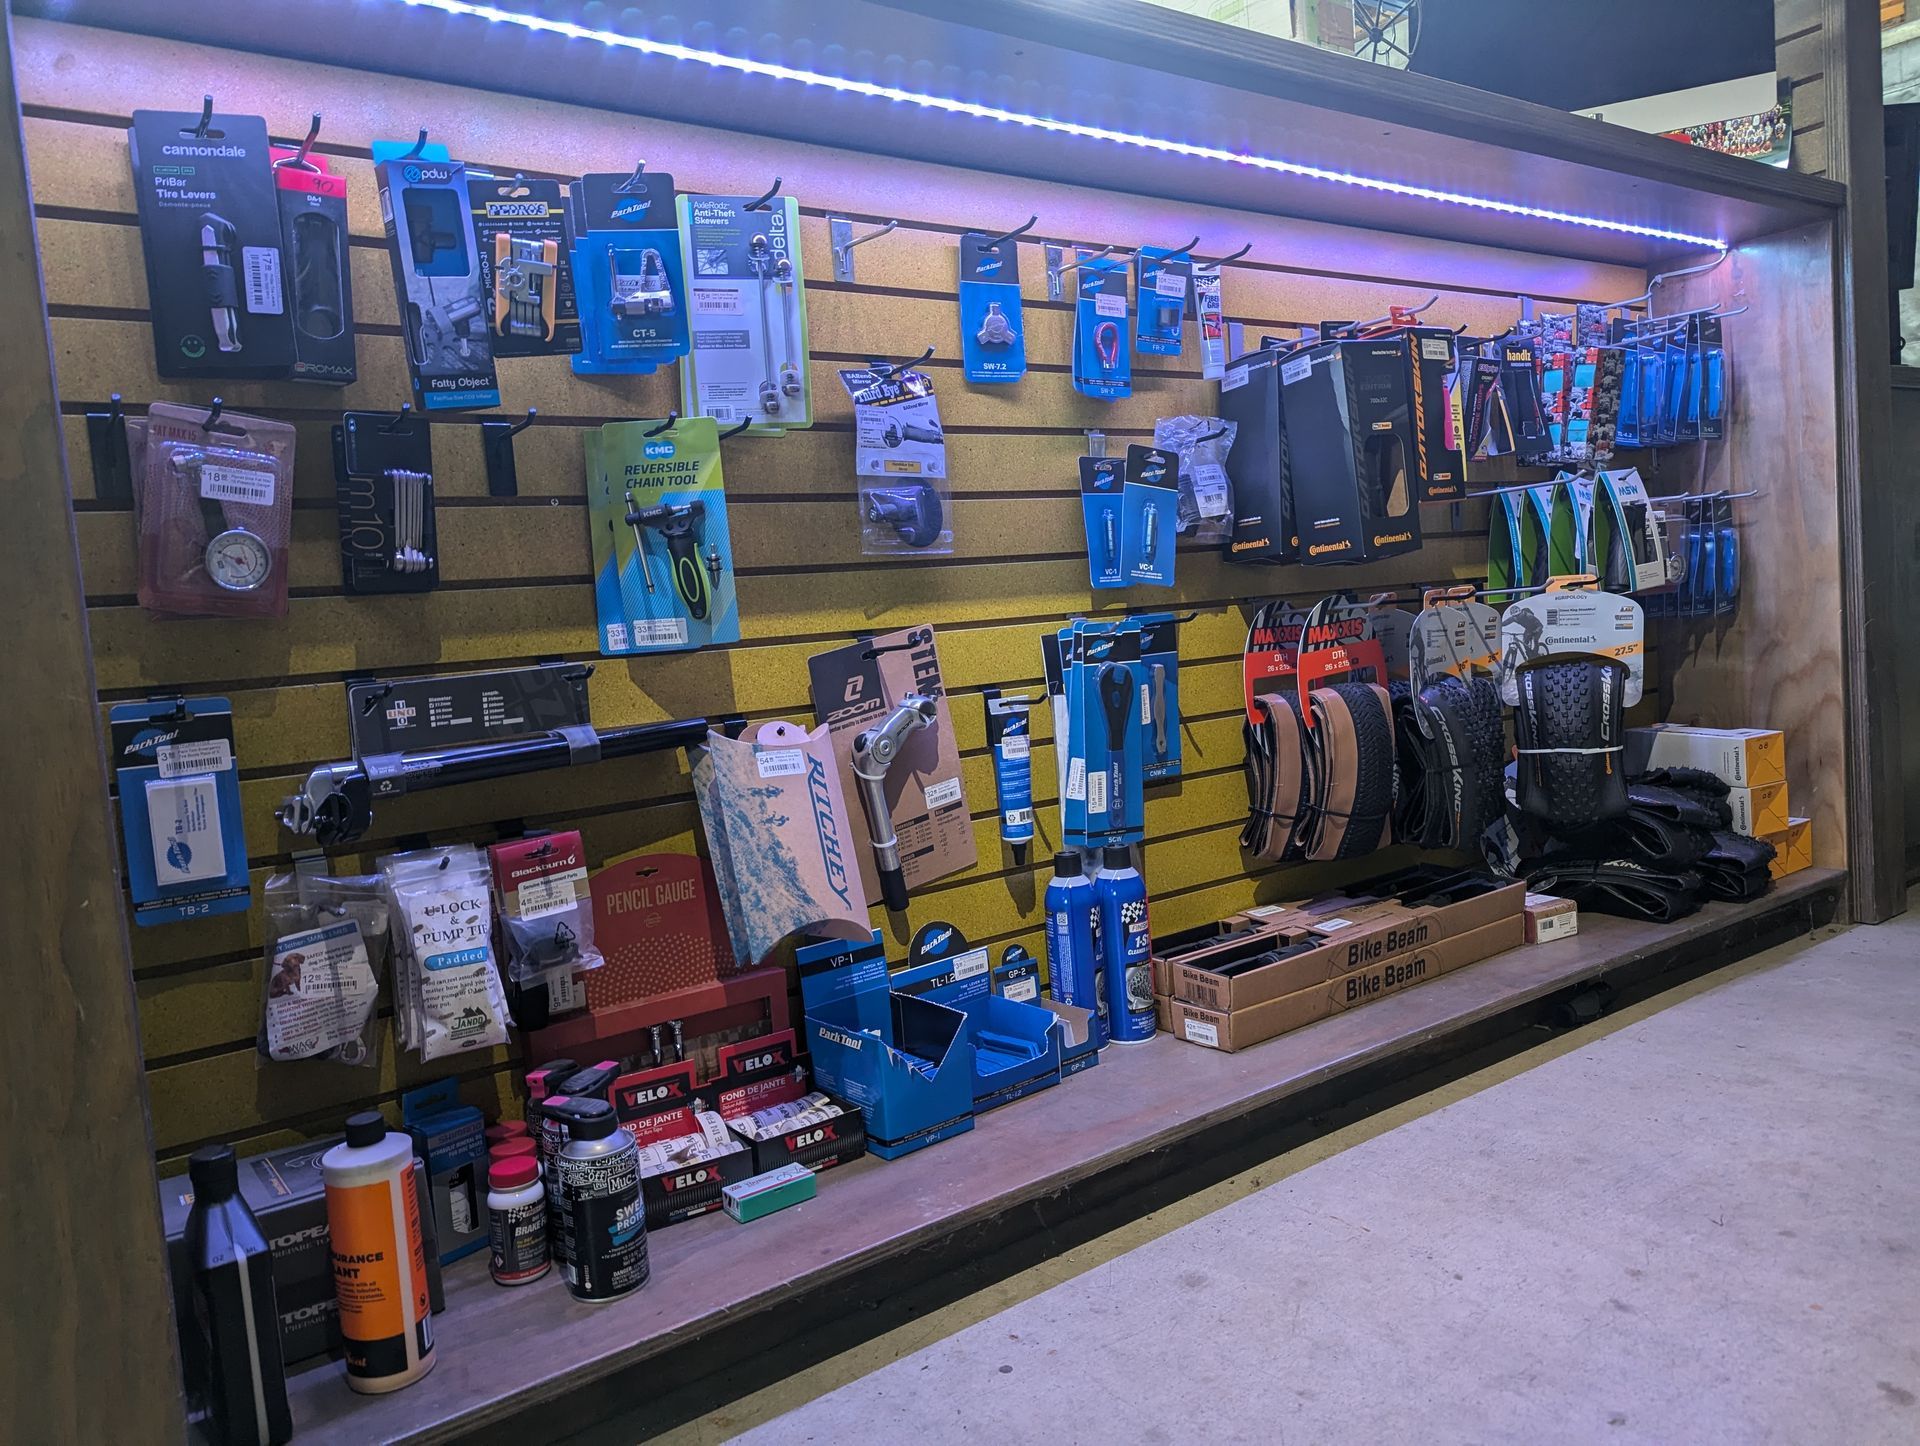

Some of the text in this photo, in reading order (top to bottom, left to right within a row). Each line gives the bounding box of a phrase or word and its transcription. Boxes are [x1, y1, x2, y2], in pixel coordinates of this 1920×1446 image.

[163, 144, 246, 158] cannondale
[155, 177, 187, 187] PriBar
[421, 169, 448, 181] pdw
[156, 189, 216, 200] Tire Levers
[693, 209, 736, 218] Anti-Theft
[694, 217, 729, 225] Skewers
[768, 213, 785, 260] delta
[632, 329, 657, 338] CT-5
[983, 362, 1007, 370] SW-7.2
[431, 377, 490, 390] Fatty Object
[859, 385, 883, 403] Third
[881, 383, 900, 398] Eye
[645, 445, 674, 455] KMC
[624, 460, 700, 476] REVERSIBLE
[625, 473, 699, 489] CHAIN TOOL
[1428, 486, 1454, 496] Continental
[1618, 485, 1638, 497] MSW
[643, 508, 663, 518] KMC
[1231, 539, 1265, 553] Continental
[1374, 533, 1407, 547] Continental
[1309, 541, 1346, 556] Continental
[1105, 568, 1118, 576] VC-1
[1139, 562, 1154, 571] VC-1
[1254, 624, 1302, 645] MAXXIS
[1308, 619, 1364, 644] MAXXIS
[1545, 635, 1590, 646] Continental
[1274, 653, 1288, 662] DTH
[1332, 649, 1348, 659] DTH
[1267, 664, 1276, 672] 26
[1325, 663, 1334, 672] 26
[1734, 750, 1742, 781] Continental
[1739, 801, 1747, 831] Continental
[807, 752, 853, 911] RITCHEY
[1108, 836, 1122, 844] SCW
[511, 858, 567, 878] Blackburn
[606, 878, 697, 916] PENCIL GAUGE
[179, 903, 210, 917] TB-2
[424, 898, 481, 917] U-LOCK
[450, 916, 460, 925] &
[422, 928, 464, 944] PUMP
[1347, 925, 1428, 967] Bike Beam
[437, 950, 484, 967] Padded
[830, 955, 853, 968] VP-1
[1008, 968, 1027, 979] GP-2
[1182, 969, 1219, 988] Bike Beam
[1346, 958, 1426, 1002] Bike Beam
[1183, 1007, 1220, 1025] Bike Beam
[734, 1051, 786, 1074] VELOX
[1070, 1061, 1086, 1071] GP-2
[623, 1082, 685, 1107] VELOX
[721, 1077, 786, 1104] FOND DE JANTE
[621, 1110, 684, 1132] ND DE JANTE
[784, 1124, 838, 1151] VELOX
[925, 1133, 941, 1144] VP-1
[661, 1163, 723, 1193] VELOX
[515, 1220, 541, 1237] BRAKE
[269, 1224, 330, 1251] TOPE
[280, 1299, 337, 1324] TOPE
